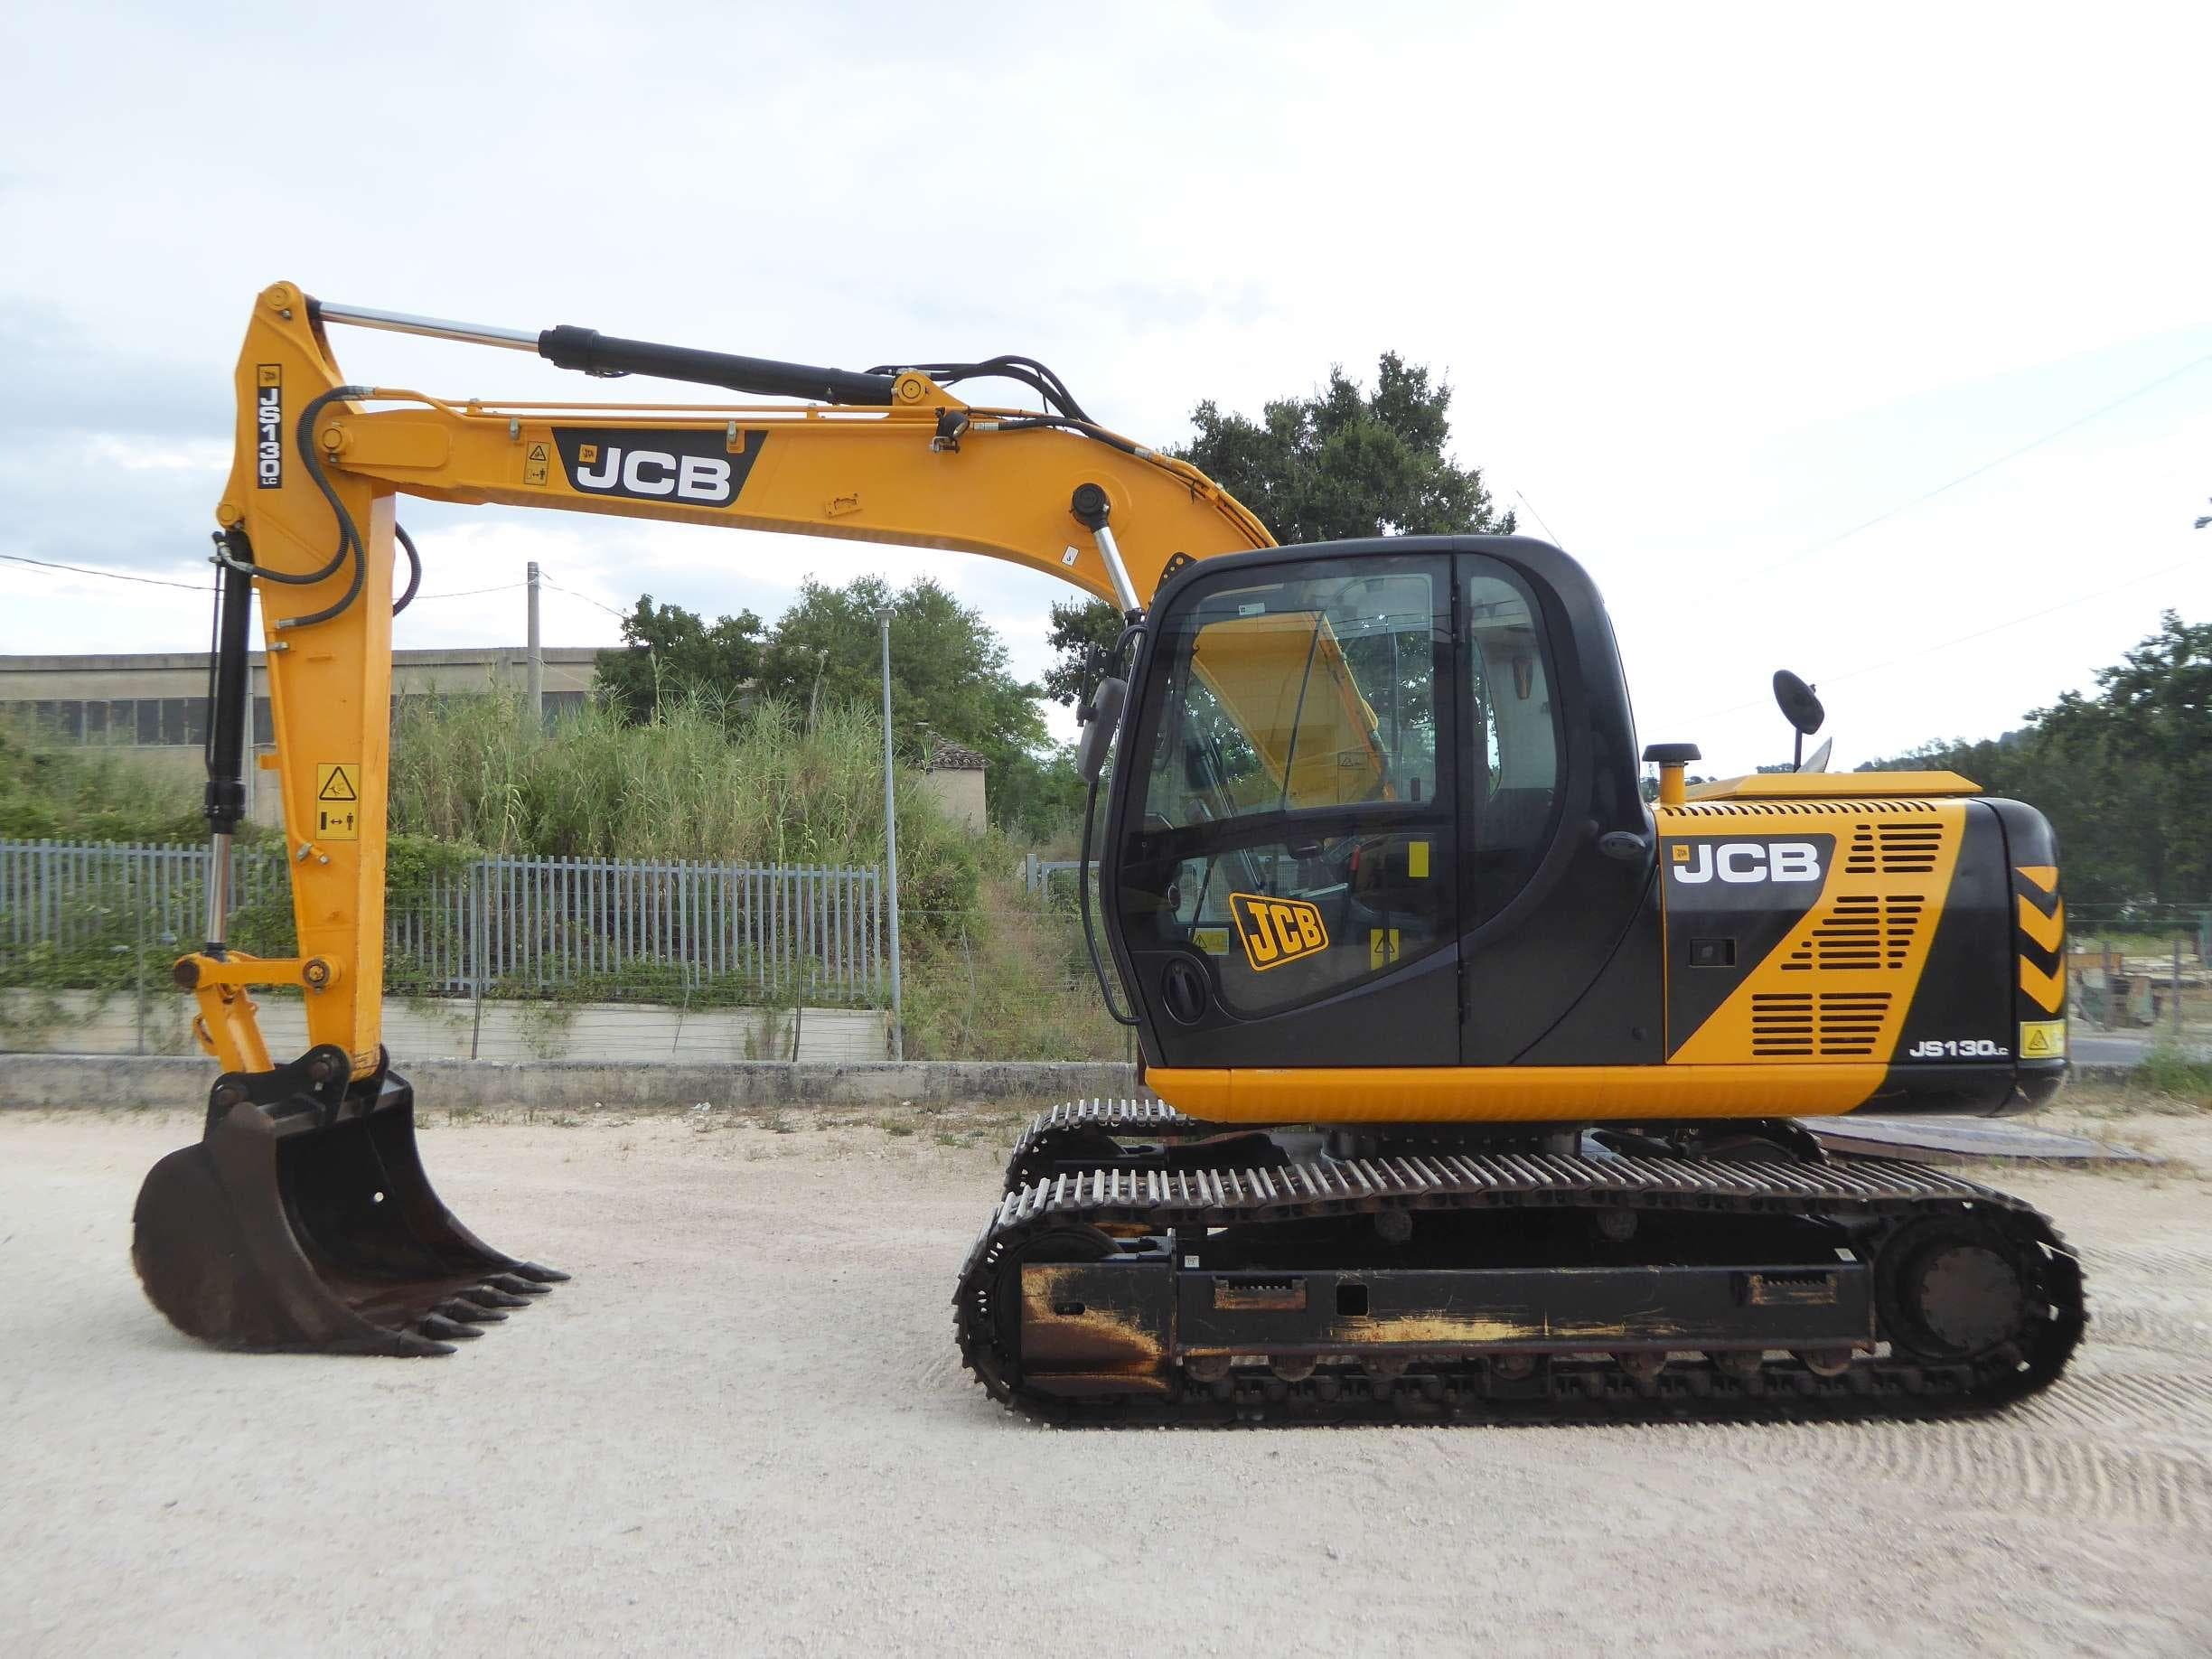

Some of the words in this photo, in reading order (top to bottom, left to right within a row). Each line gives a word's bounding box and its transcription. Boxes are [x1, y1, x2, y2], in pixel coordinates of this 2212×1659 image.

[576, 447, 731, 501] JCB
[1673, 843, 1821, 883] JCB
[1247, 901, 1322, 961] JCB
